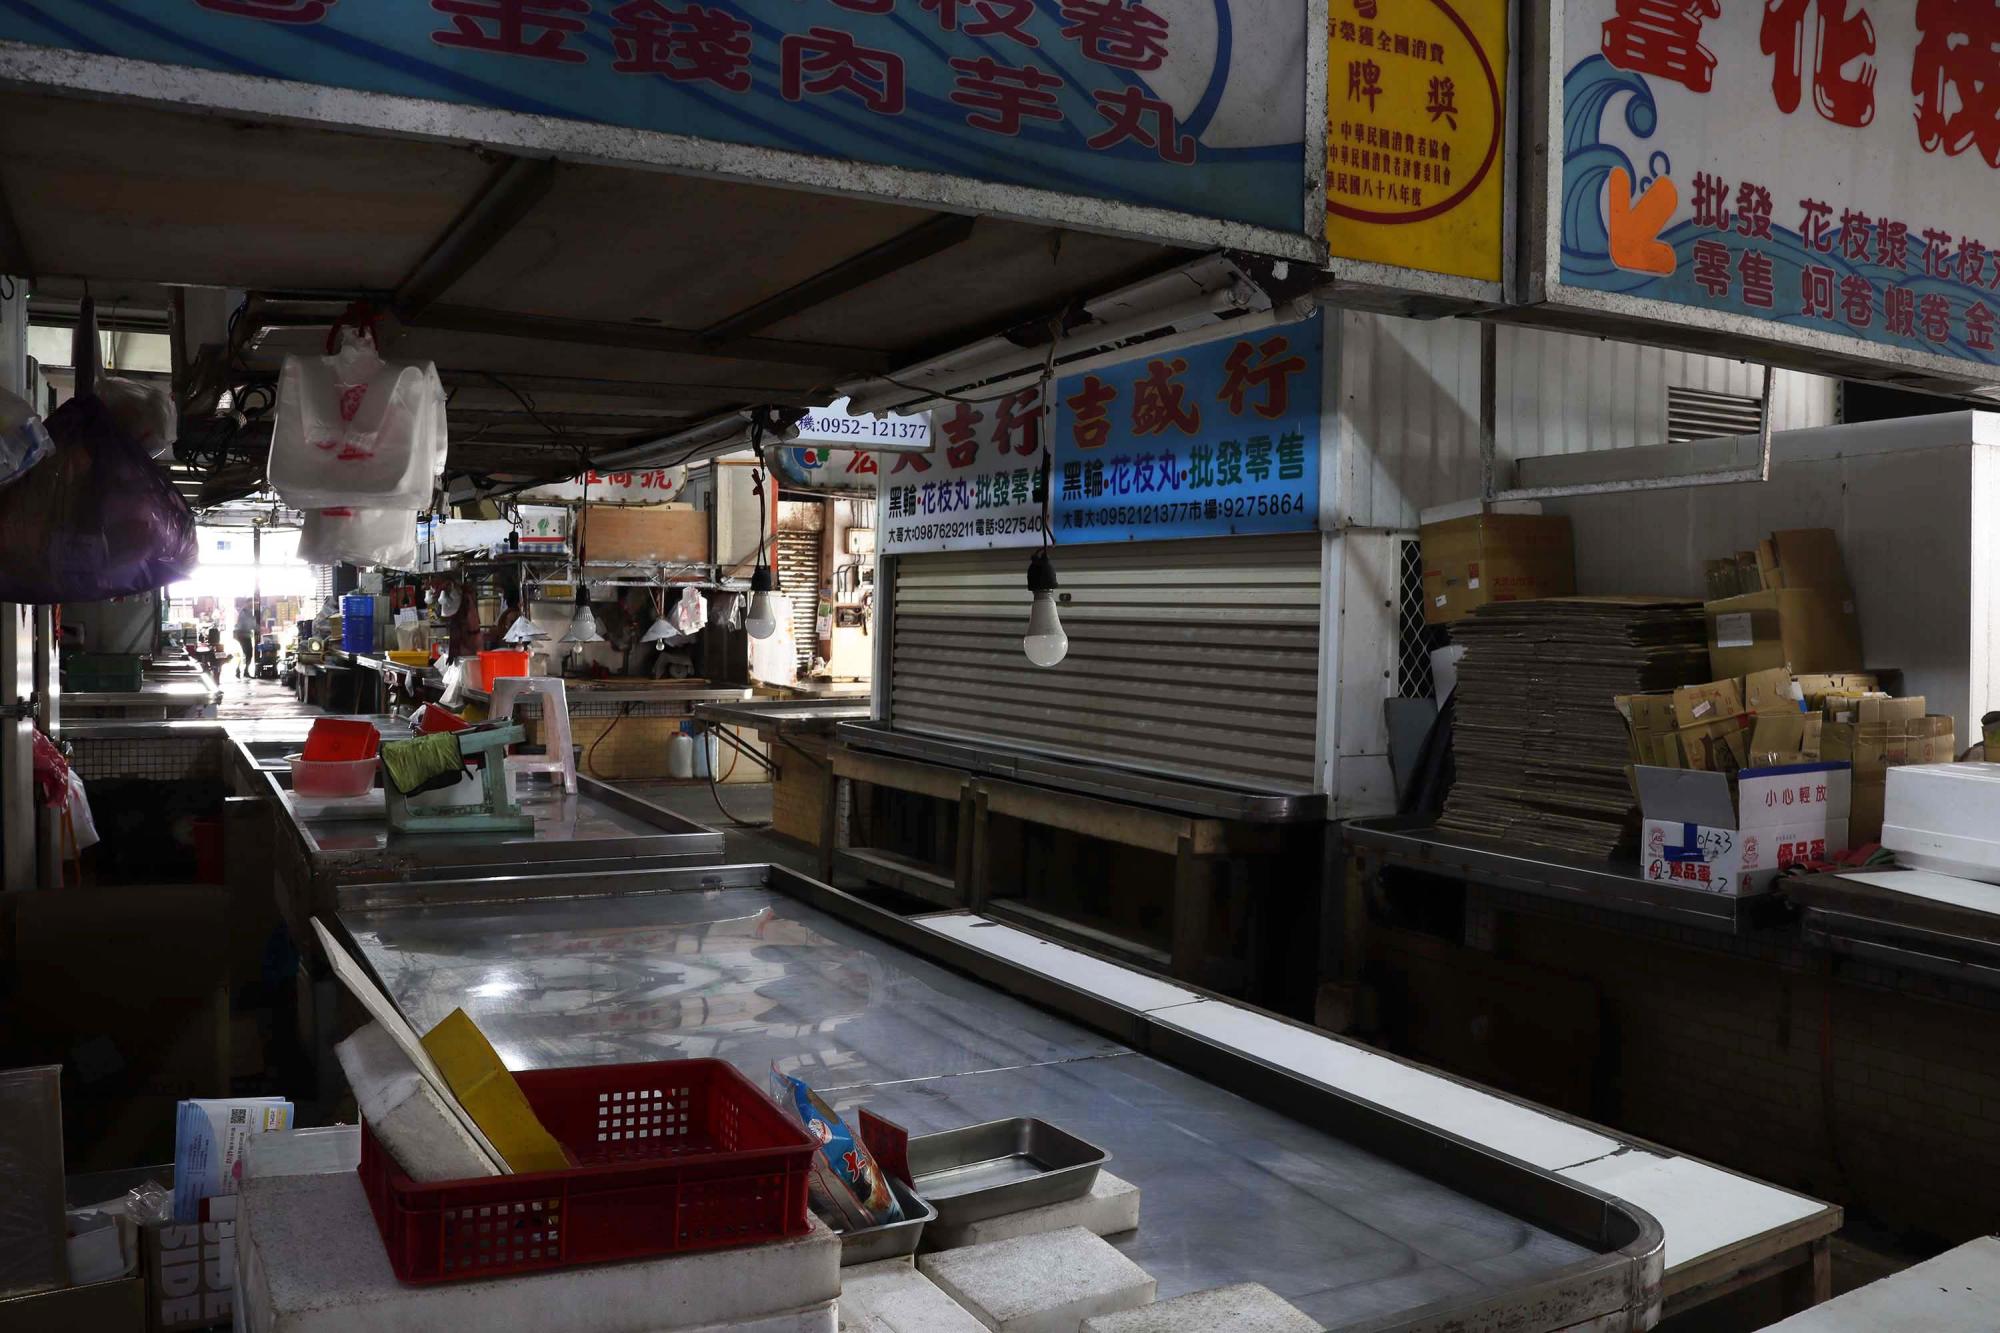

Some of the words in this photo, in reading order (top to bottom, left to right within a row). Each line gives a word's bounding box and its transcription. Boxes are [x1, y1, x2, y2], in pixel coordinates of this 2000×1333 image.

[1691, 171, 1773, 241] 批發
[1692, 239, 1774, 310] 零售
[1765, 784, 1827, 807] 小心輕放
